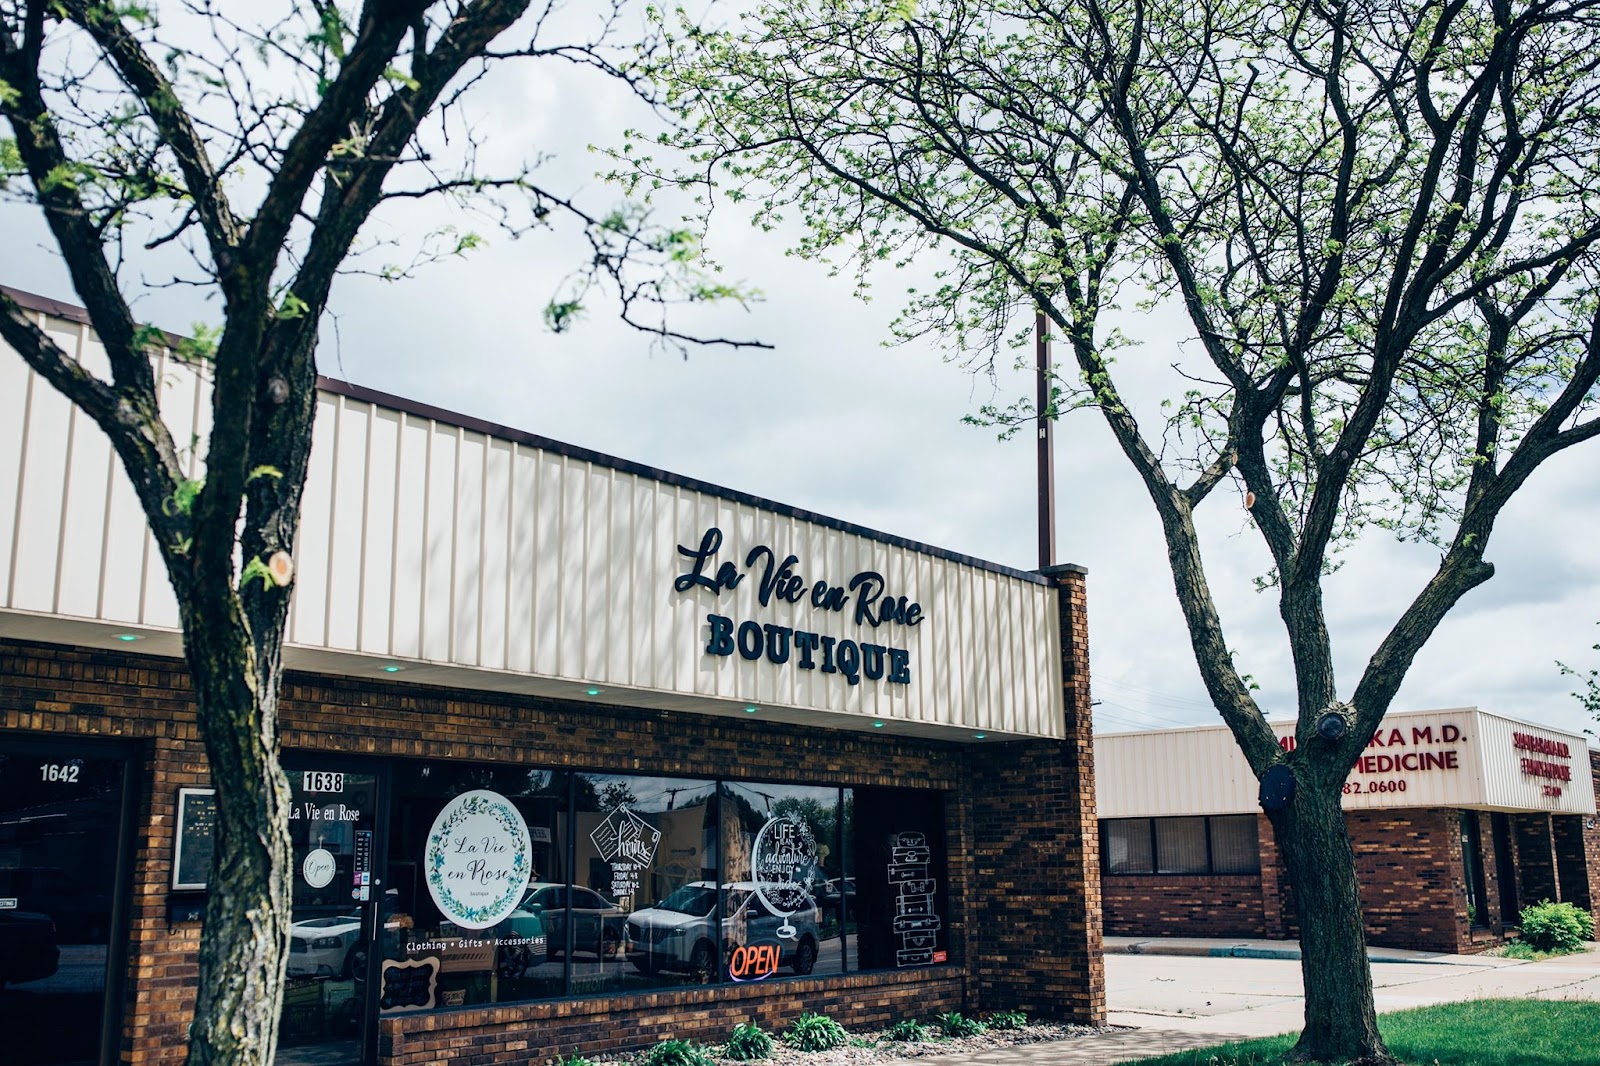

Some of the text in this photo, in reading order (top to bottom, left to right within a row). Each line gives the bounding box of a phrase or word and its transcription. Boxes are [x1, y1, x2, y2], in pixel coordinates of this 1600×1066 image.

[675, 527, 925, 628] La Vie en Rose
[706, 613, 911, 686] BOUTIQUE
[1412, 724, 1467, 746] M.D.
[40, 764, 79, 783] 1642
[306, 772, 342, 792] 1638
[288, 802, 360, 822] La Vie en Rose
[610, 820, 652, 857] hours
[774, 823, 796, 839] LIFE
[454, 836, 508, 854] La Vie
[765, 841, 811, 866] adventure
[308, 860, 331, 879] Open
[448, 858, 512, 886] en Rose
[772, 864, 795, 874] ENJOY
[406, 935, 544, 952] Clothing Gifts Accessories
[732, 944, 780, 977] OPEN
